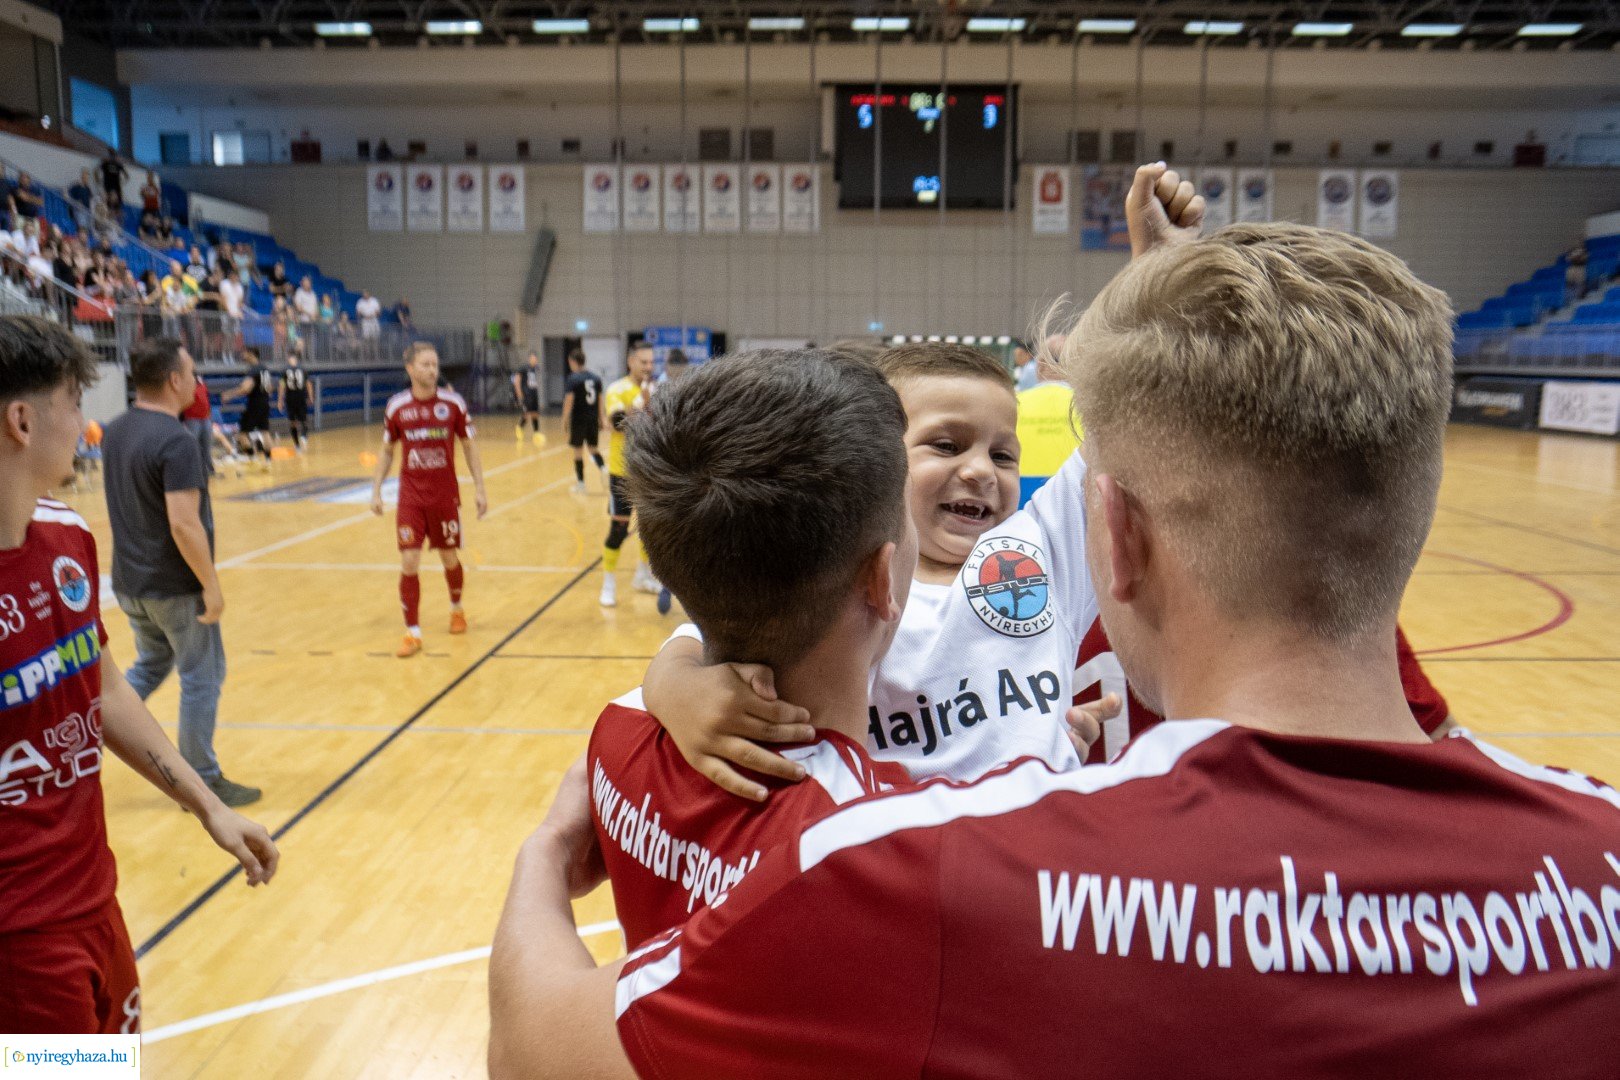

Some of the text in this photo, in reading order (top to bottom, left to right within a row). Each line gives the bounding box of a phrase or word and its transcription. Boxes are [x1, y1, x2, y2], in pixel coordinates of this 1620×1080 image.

[584, 379, 596, 405] 5
[441, 519, 459, 538] 19
[968, 539, 1041, 571] FUTSAL
[867, 677, 988, 757] Hajrá
[592, 757, 761, 914] www.raktarsport
